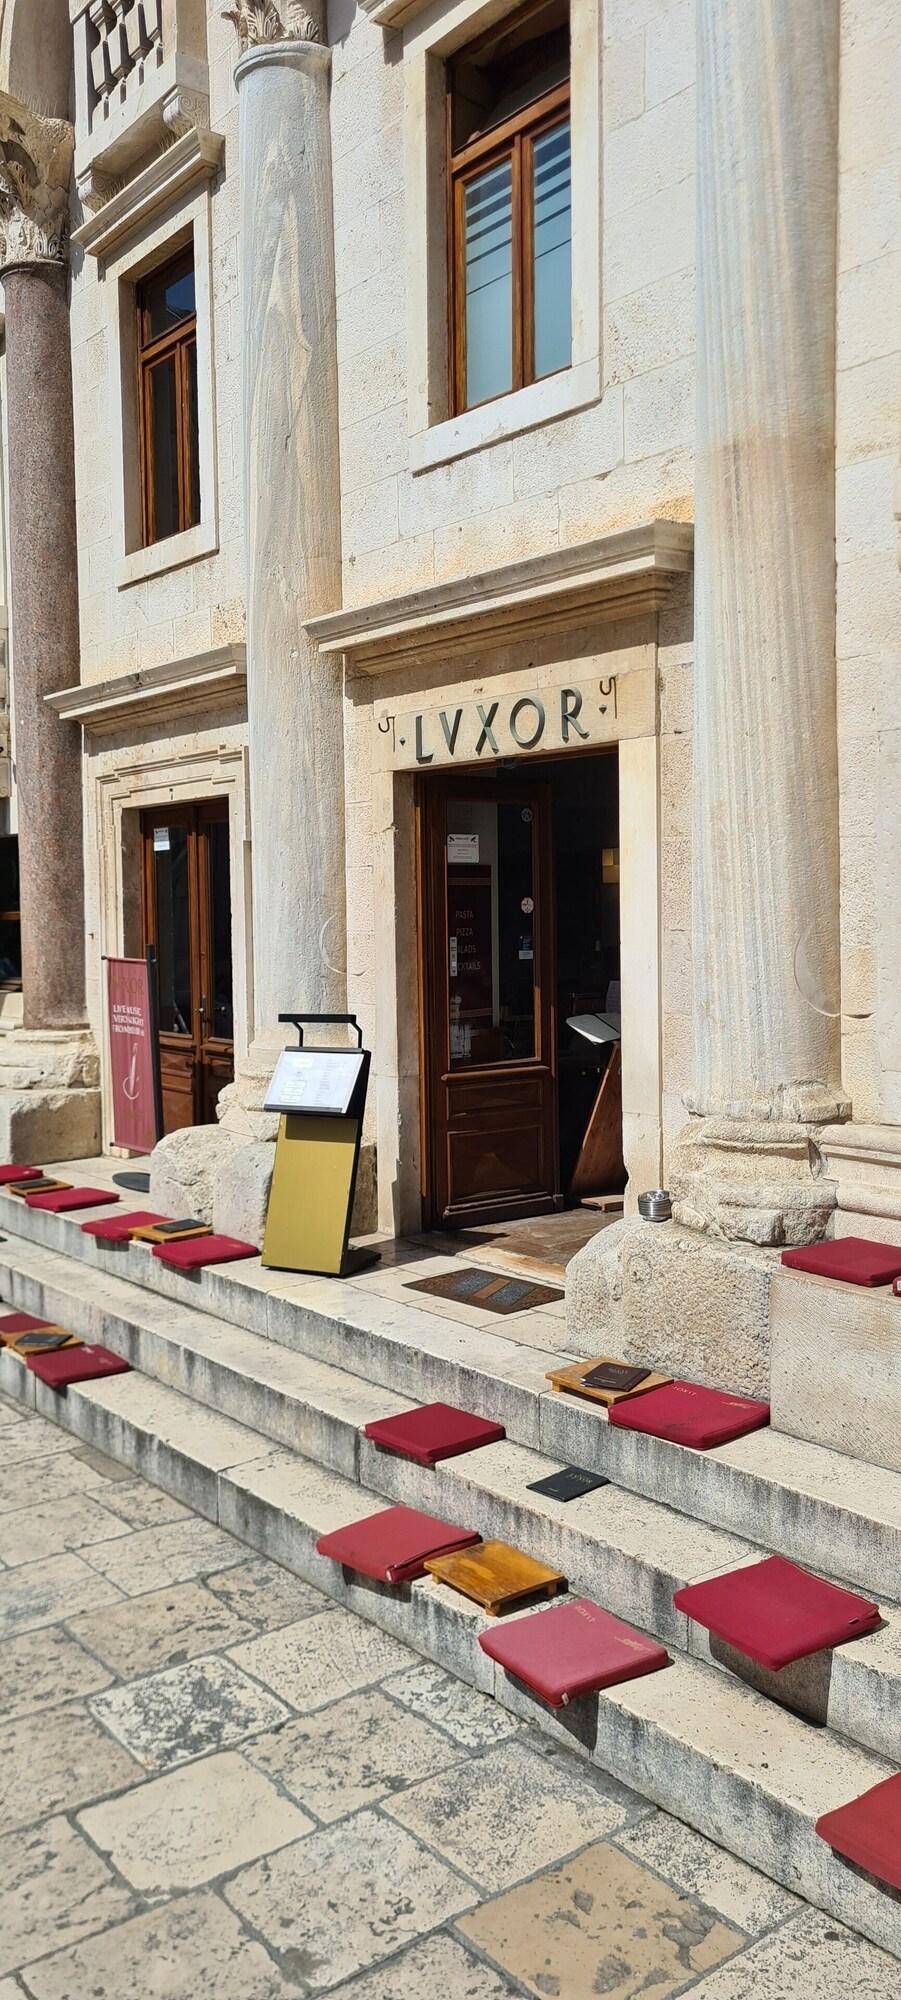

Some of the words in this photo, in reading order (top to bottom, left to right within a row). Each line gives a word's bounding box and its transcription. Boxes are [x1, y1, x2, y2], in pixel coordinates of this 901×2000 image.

[415, 688, 590, 764] LVXOR
[455, 910, 474, 919] PASTA
[455, 928, 474, 936] PIZZA
